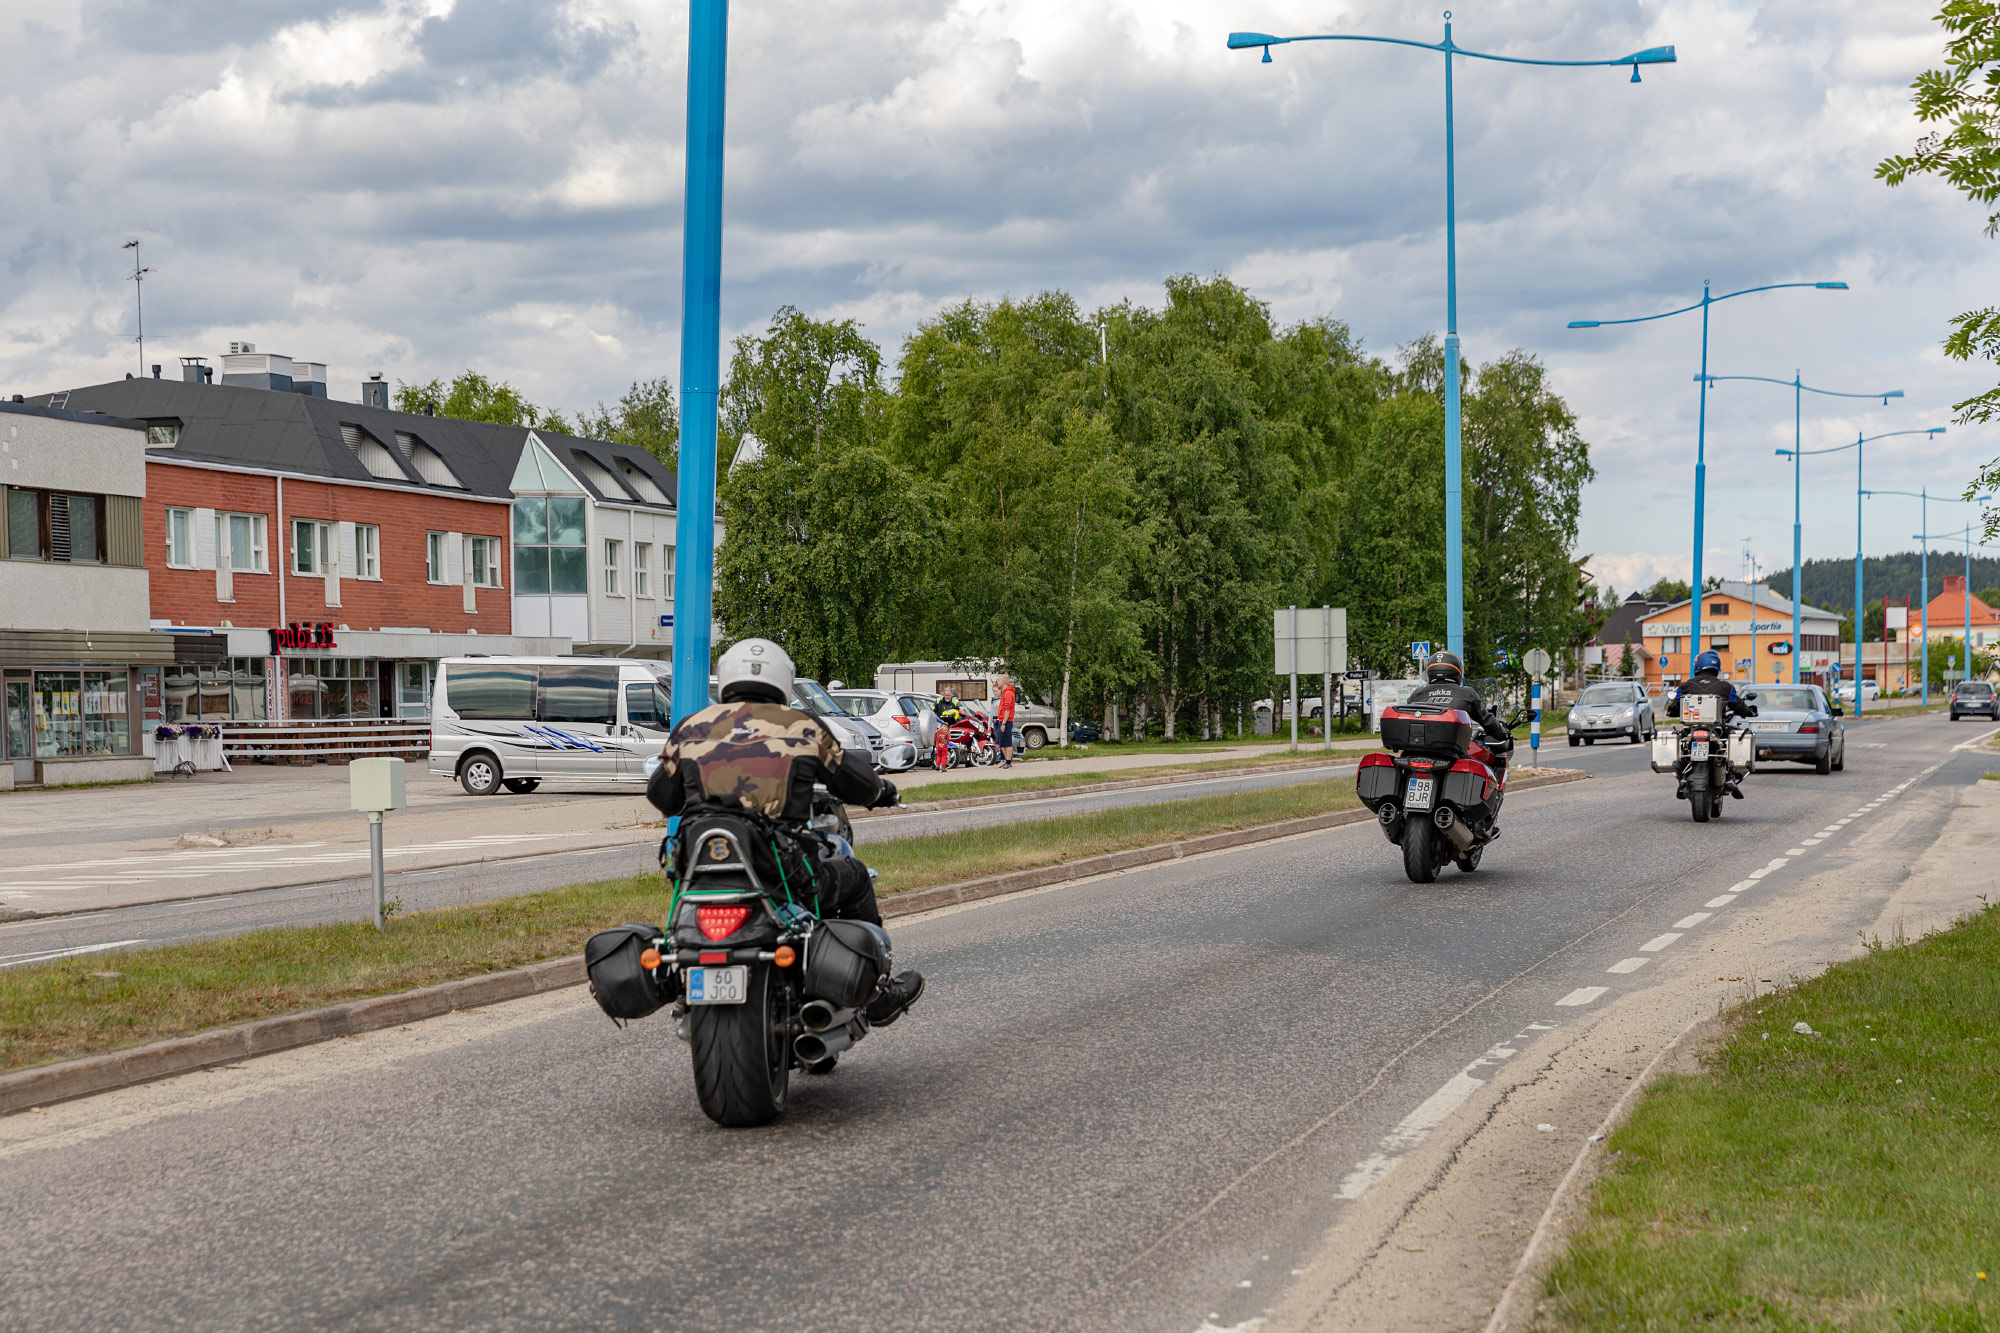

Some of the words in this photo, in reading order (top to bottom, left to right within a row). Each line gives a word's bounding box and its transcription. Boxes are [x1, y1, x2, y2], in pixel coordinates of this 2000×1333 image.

[1662, 623, 1716, 634] Värismä
[1417, 781, 1430, 791] 98
[1409, 791, 1429, 802] BJR
[715, 970, 732, 985] 60
[710, 985, 736, 999] JCO
